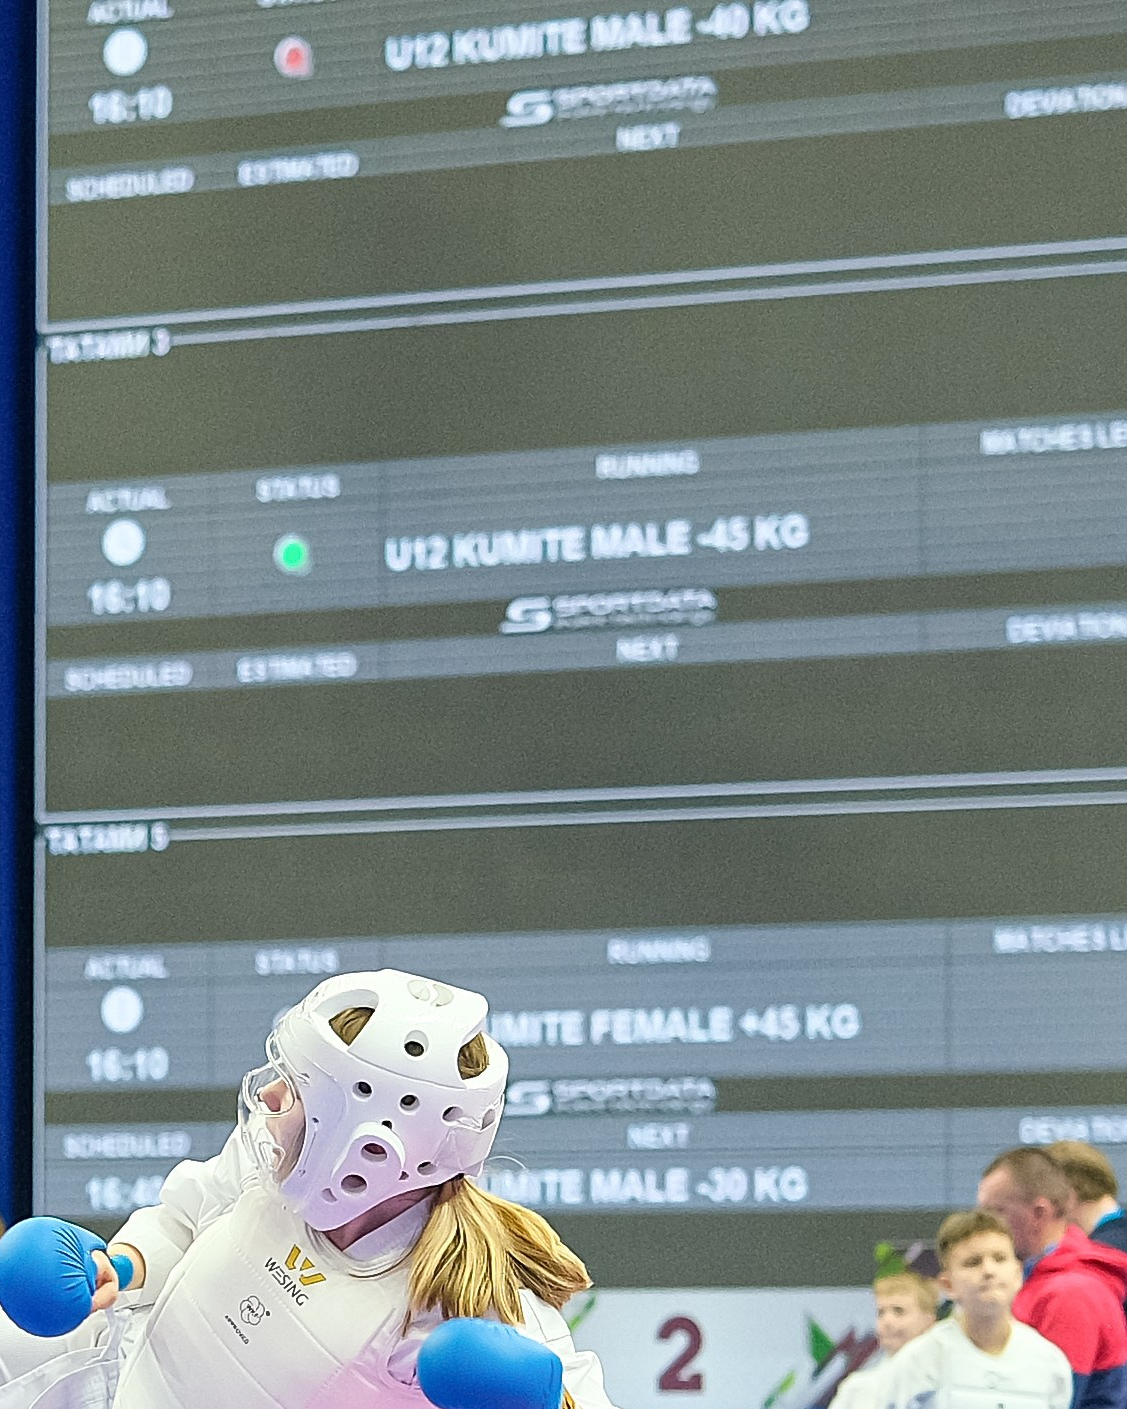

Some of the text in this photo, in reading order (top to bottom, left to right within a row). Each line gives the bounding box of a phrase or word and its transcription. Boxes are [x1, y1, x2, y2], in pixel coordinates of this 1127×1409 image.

[386, 0, 810, 70] U12 KUMITE MALE -40 KG
[616, 122, 680, 151] NEXT
[85, 487, 172, 513] ACTUAL
[385, 513, 809, 571] U12 KUMITE MALE -45 KG
[616, 633, 679, 662] NEXT
[85, 953, 169, 980] ACTUAL
[590, 1006, 734, 1044] FEMALE
[738, 1004, 801, 1041] +45
[805, 1004, 861, 1040] KG
[86, 1047, 170, 1082] 16:10
[627, 1122, 691, 1149] NEXT
[590, 1167, 690, 1203] MALE
[696, 1166, 748, 1203] -30
[754, 1165, 809, 1202] KG
[265, 1257, 309, 1306] WESING
[656, 1316, 703, 1392] 2
